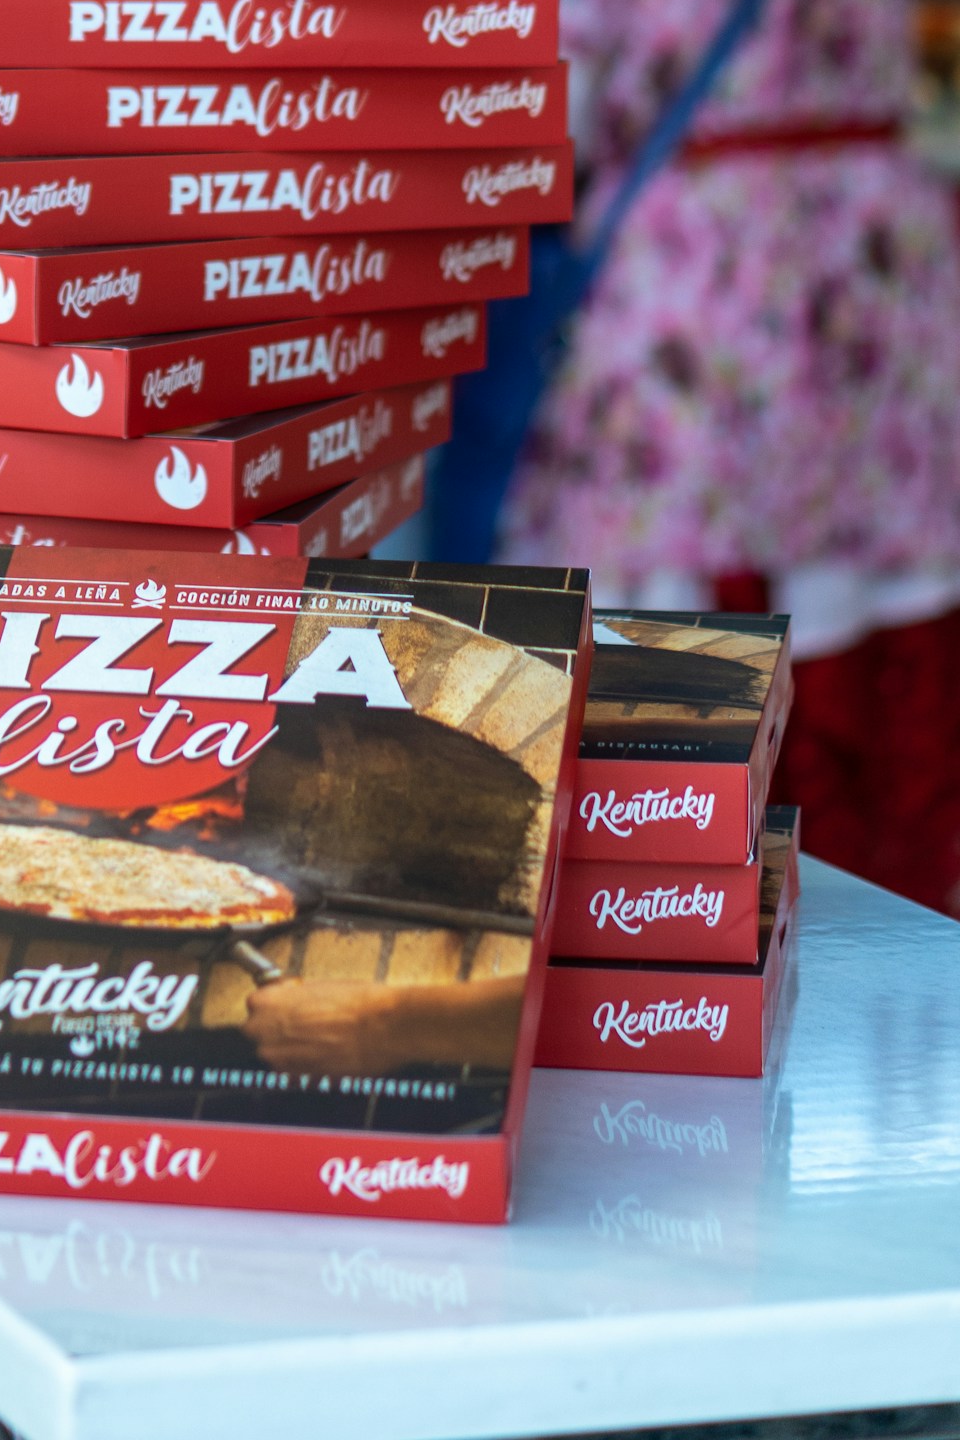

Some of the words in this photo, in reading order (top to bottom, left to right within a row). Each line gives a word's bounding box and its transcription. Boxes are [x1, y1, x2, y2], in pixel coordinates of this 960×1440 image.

[440, 79, 548, 128] Kentucky
[462, 156, 557, 207] Kentucky
[58, 267, 142, 318] Kentucky
[142, 356, 204, 410] Kentucky
[55, 585, 66, 599] A
[76, 583, 121, 601] LEÑA
[176, 589, 250, 607] COCCIÓN
[256, 594, 302, 609] FINAL
[310, 597, 329, 611] 10
[336, 598, 413, 614] MINUTOS
[580, 785, 715, 838] Kentucky
[589, 883, 724, 935] Kentucky
[593, 997, 728, 1047] Kentucky
[321, 1156, 469, 1202] Kentucky
